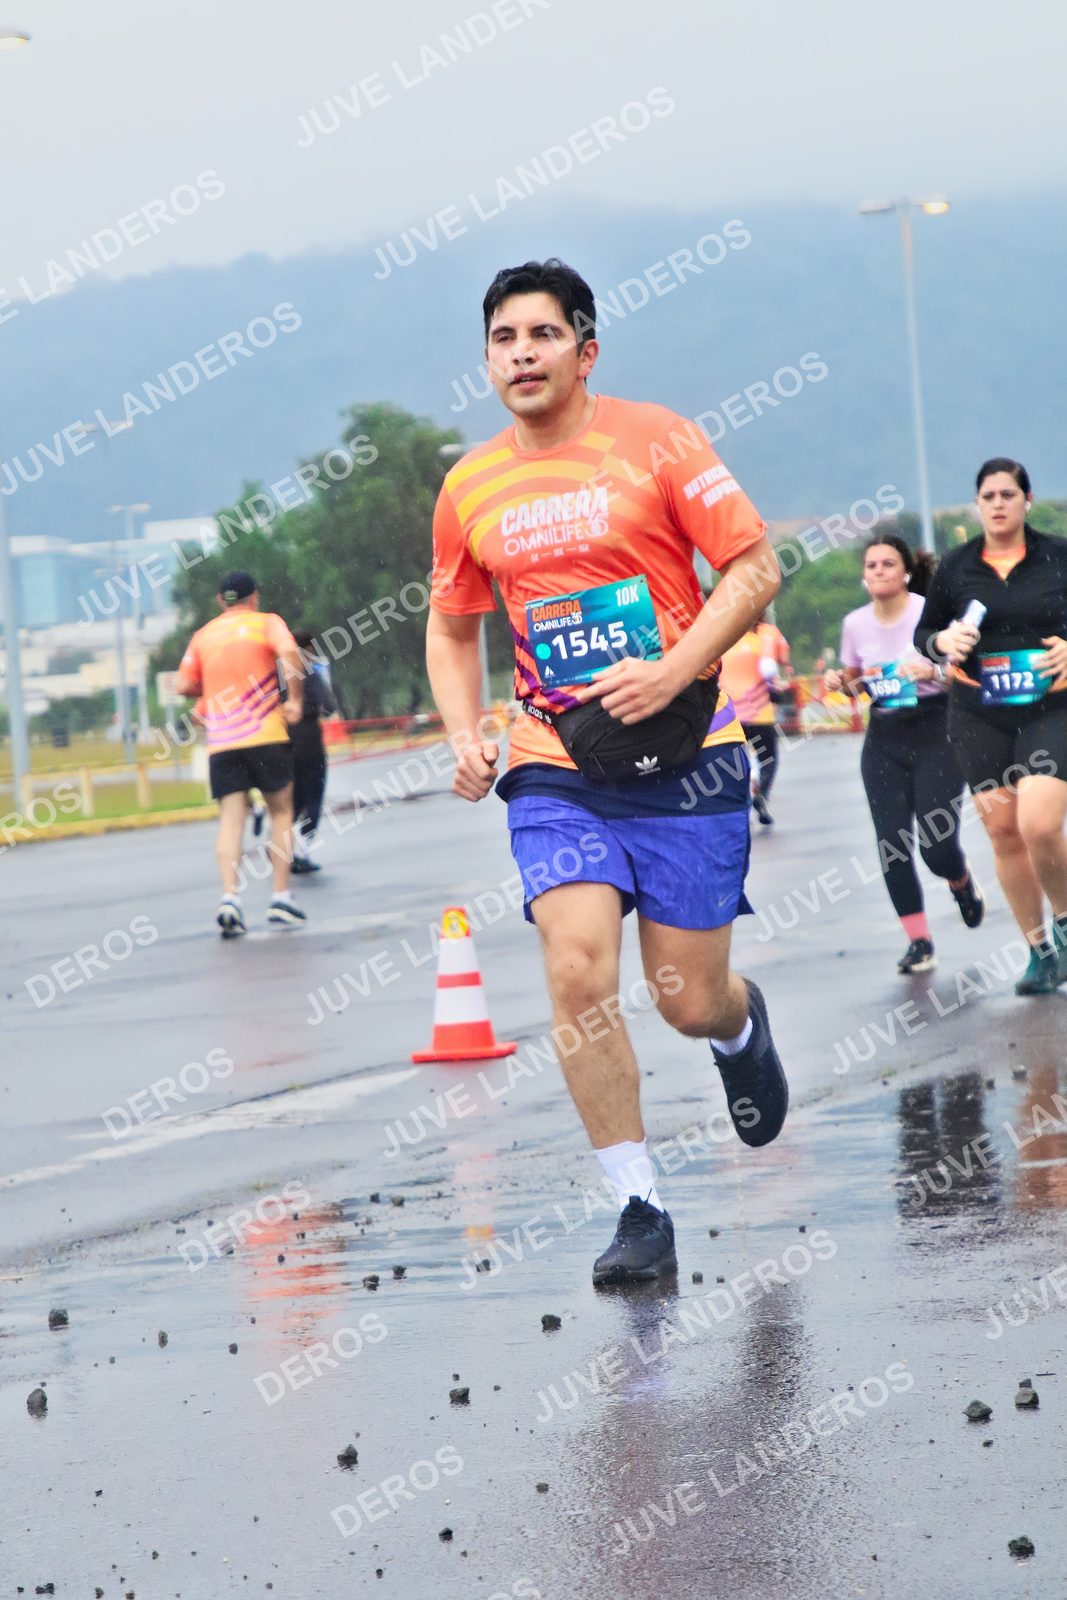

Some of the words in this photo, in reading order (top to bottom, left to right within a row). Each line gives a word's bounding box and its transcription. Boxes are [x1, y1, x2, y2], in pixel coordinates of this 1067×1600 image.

[501, 487, 608, 536] CARRERA
[615, 584, 640, 607] 10K
[532, 600, 581, 623] CARRERA
[551, 620, 628, 660] 1545
[990, 671, 1035, 690] 1172
